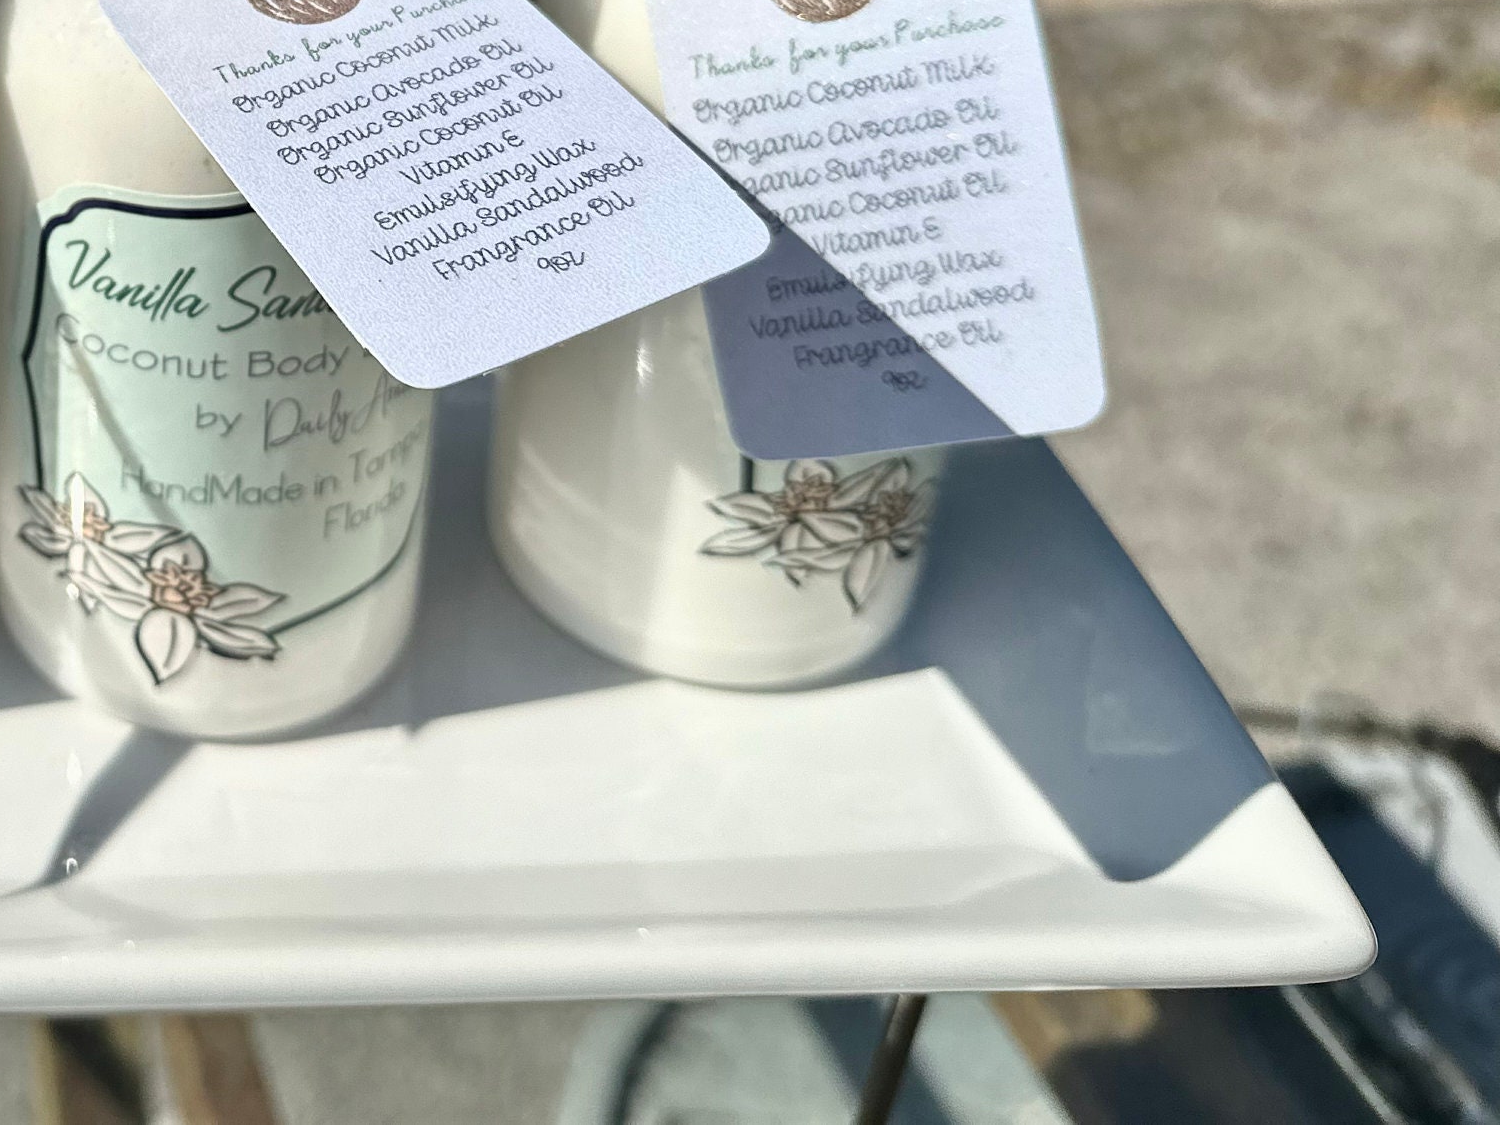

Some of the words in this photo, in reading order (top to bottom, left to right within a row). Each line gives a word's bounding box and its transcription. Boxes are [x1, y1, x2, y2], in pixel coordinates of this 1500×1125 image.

[213, 49, 295, 84] Thanks
[301, 37, 343, 62] for
[346, 19, 394, 48] your
[232, 70, 336, 113] Organic
[335, 34, 435, 77] Coconut
[432, 13, 499, 43] Milk
[689, 45, 776, 79] Thanks
[787, 37, 828, 74] for
[835, 35, 891, 66] your
[894, 9, 1006, 46] Purchase
[266, 94, 370, 138] Organic
[371, 55, 481, 102] Avocado
[479, 38, 522, 61] Oil
[280, 121, 383, 166] Organic
[382, 74, 512, 128] Sunflower
[510, 56, 554, 80] Oil
[692, 90, 803, 126] Organic
[806, 65, 918, 105] Coconut
[921, 52, 997, 85] Milk
[313, 139, 420, 184] Organic
[419, 99, 522, 147] Coconut
[518, 84, 563, 108] Oil
[399, 140, 505, 185] Vitamin
[502, 129, 525, 148] E
[712, 129, 823, 166] Organic
[827, 107, 951, 146] Avocado
[954, 94, 1001, 125] Oil
[373, 160, 538, 231] Emulsifying
[535, 137, 596, 170] Wax
[742, 167, 821, 202] ganic
[824, 145, 969, 182] Sunflower
[973, 129, 1020, 159] Oil
[849, 175, 961, 215] Coconut
[962, 169, 1009, 198] Oil
[370, 220, 478, 266] Vanilla
[476, 151, 644, 227] Sandalwood
[432, 211, 591, 280] Frangrance
[587, 190, 635, 218] Oil
[811, 221, 919, 258] Vitamin
[922, 216, 944, 240] E
[65, 239, 209, 323] Vanilla
[536, 251, 586, 274] 9oz
[765, 258, 937, 303] Emulsifying
[938, 248, 1003, 275] Wax
[751, 305, 850, 339] Vanilla
[855, 277, 1036, 326] Sandalwood
[55, 312, 228, 380] Coconut
[248, 344, 350, 378] Body
[793, 326, 953, 370] Frangrance
[956, 318, 1003, 346] Oil
[196, 402, 242, 437] by
[121, 461, 304, 506] HandMade
[313, 473, 338, 497] in
[323, 476, 407, 540] Florida
